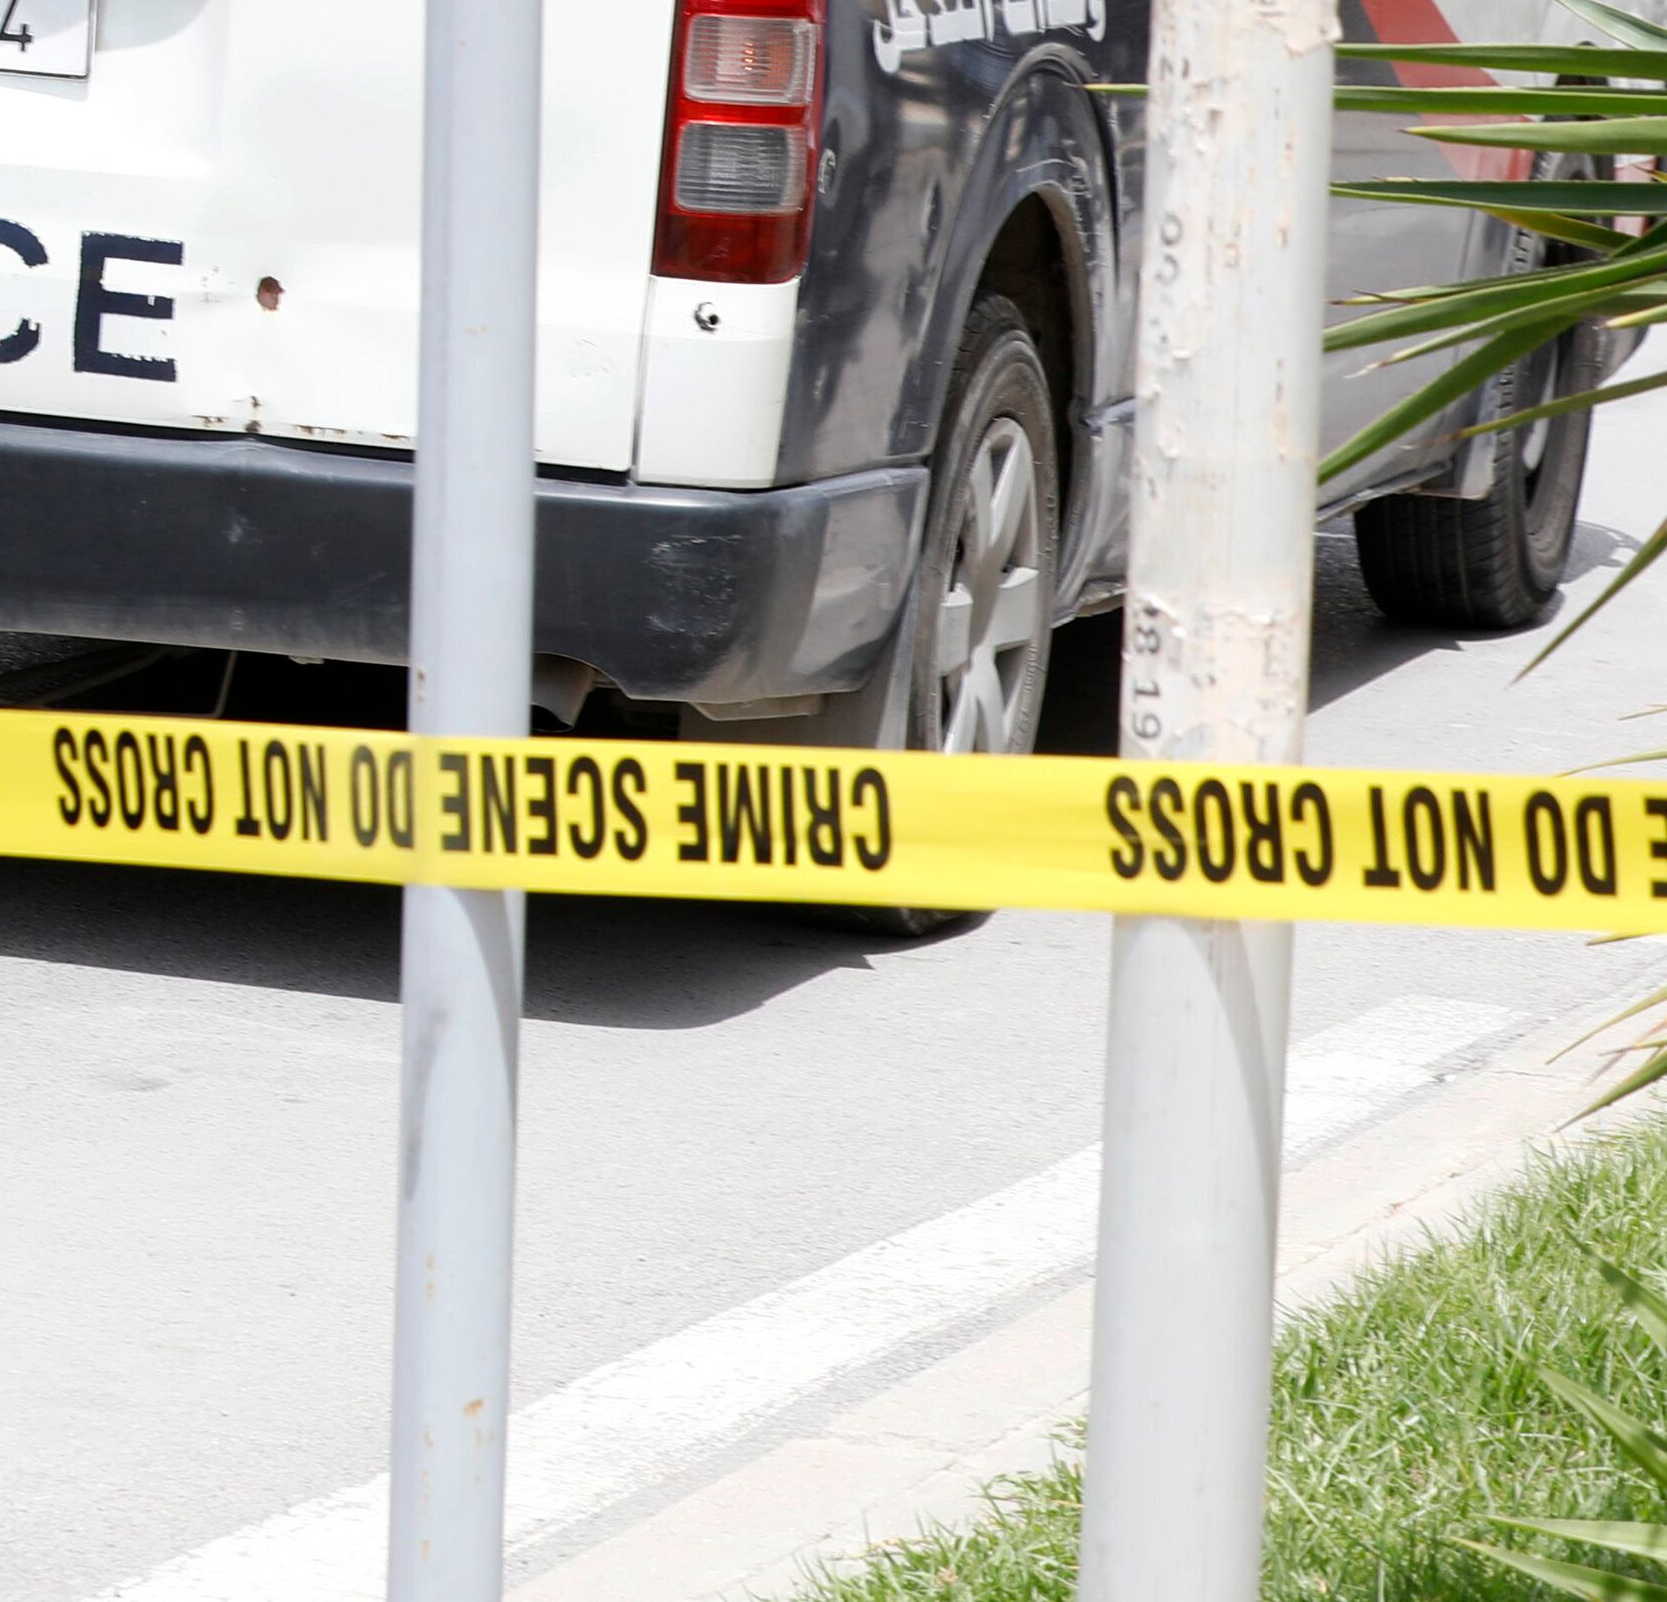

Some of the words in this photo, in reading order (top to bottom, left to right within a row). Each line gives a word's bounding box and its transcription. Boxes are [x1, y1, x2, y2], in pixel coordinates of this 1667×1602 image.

[52, 726, 215, 835] CROSS
[235, 738, 329, 842] NOT
[351, 746, 415, 849] DO
[440, 753, 648, 861] SCENE
[675, 761, 893, 871] CRIME
[1104, 774, 1335, 888] CROSS
[1363, 784, 1497, 893] NOT
[1522, 789, 1618, 897] DO
